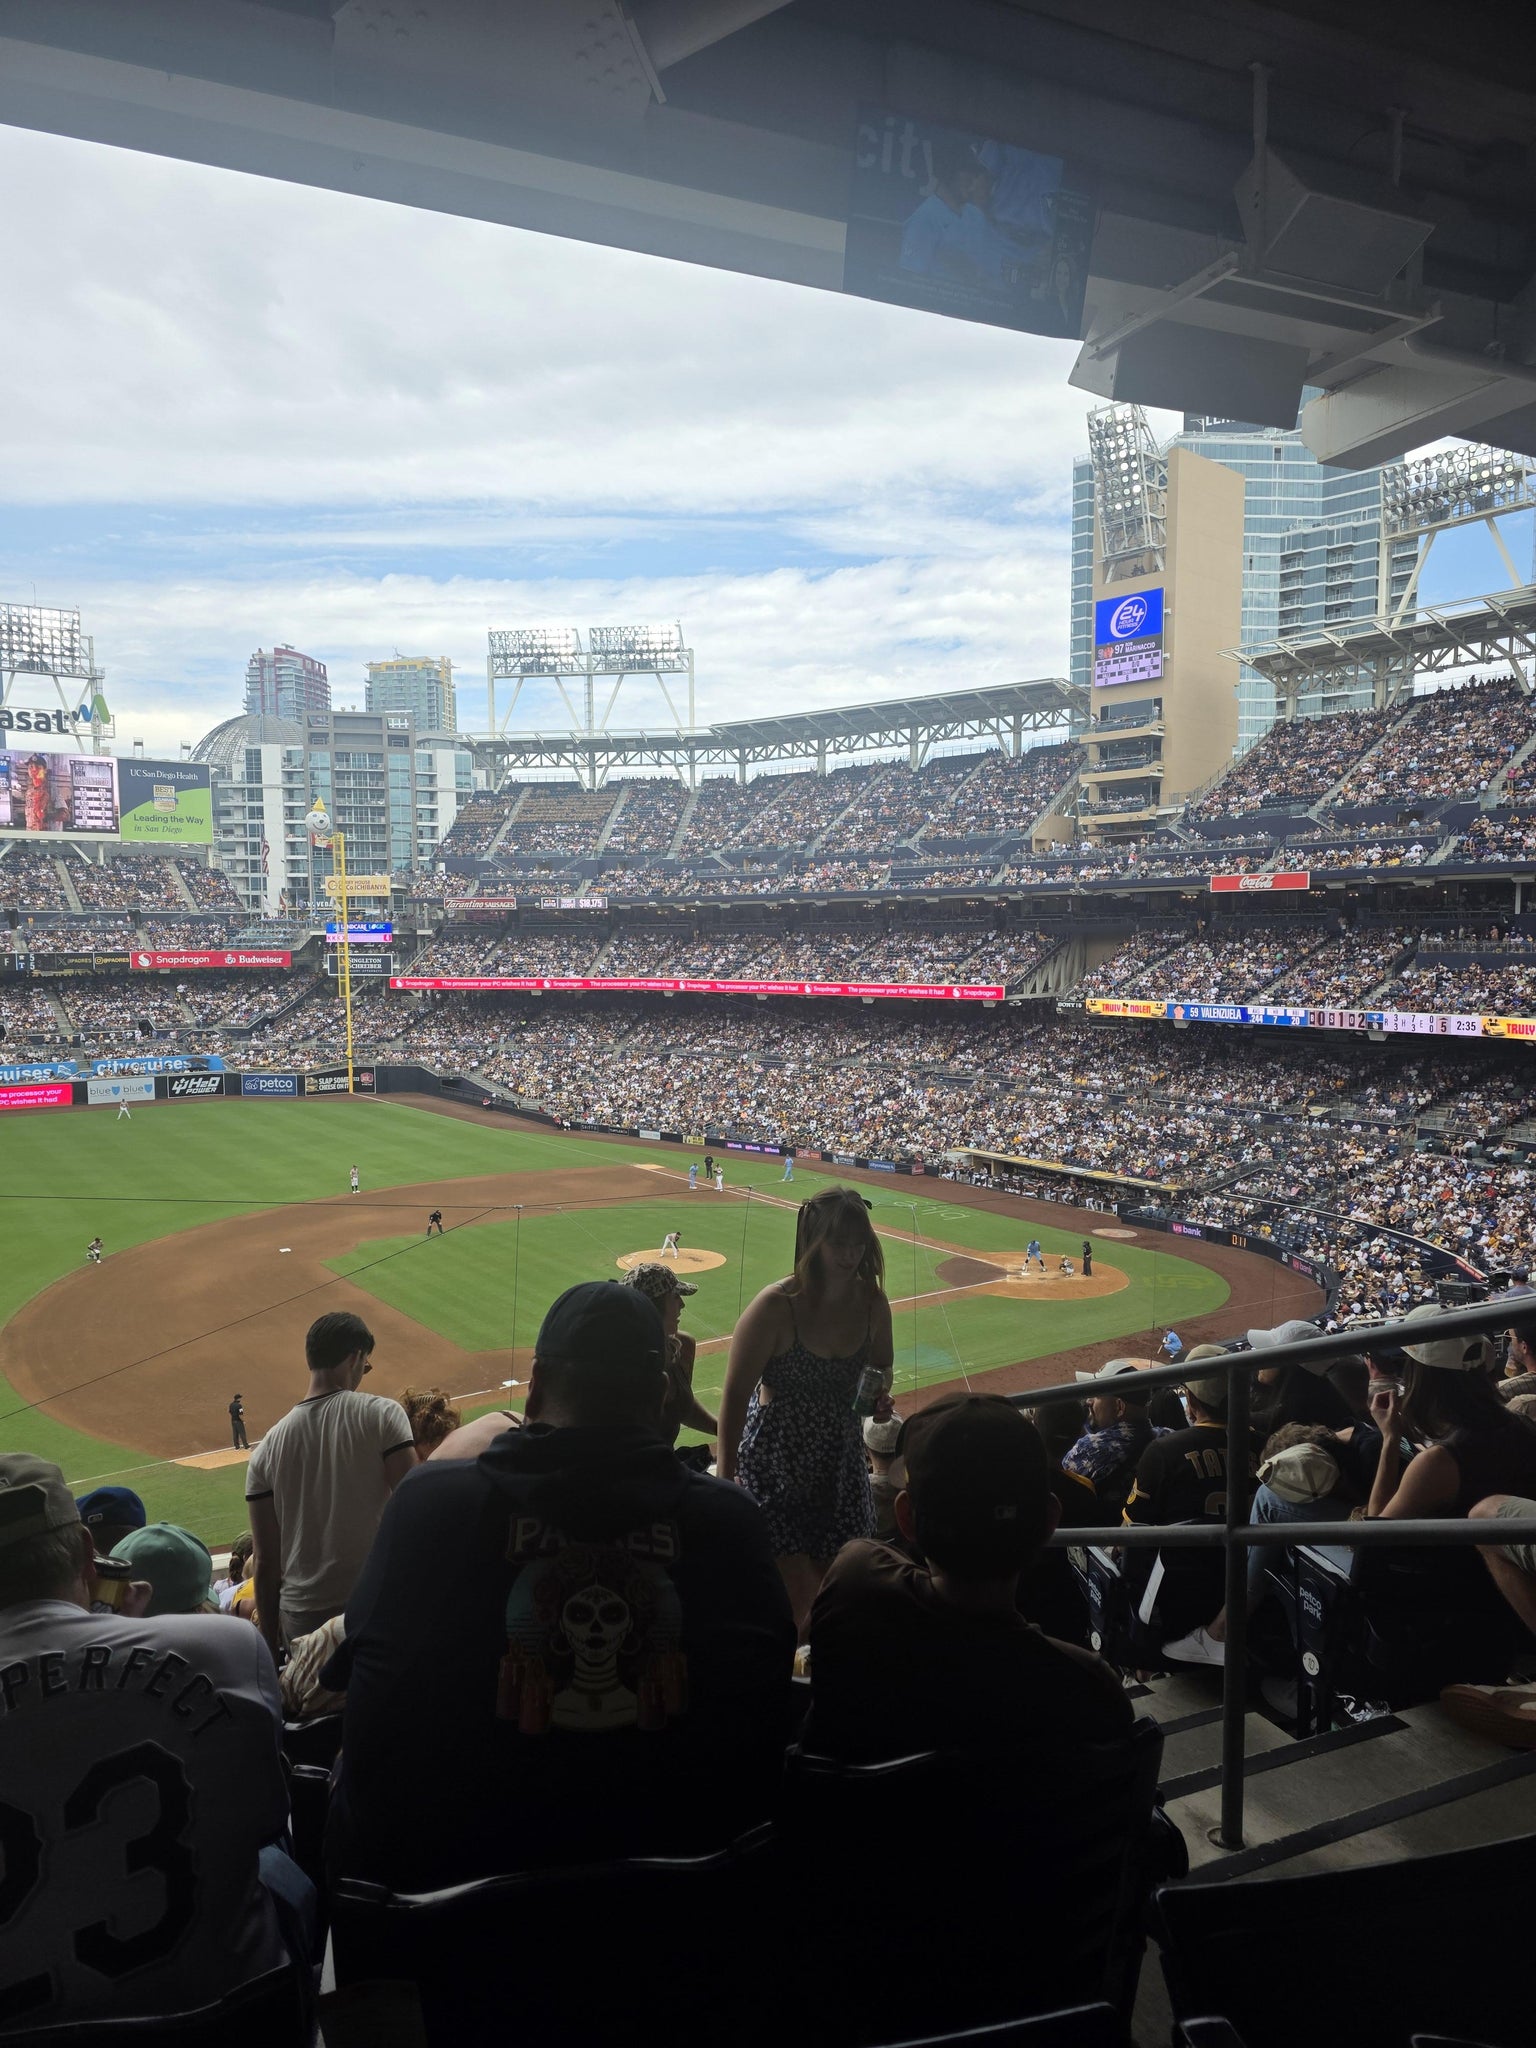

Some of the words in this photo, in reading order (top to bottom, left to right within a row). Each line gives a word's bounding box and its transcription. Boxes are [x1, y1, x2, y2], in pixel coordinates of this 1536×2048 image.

[1120, 604, 1144, 622] 24
[1114, 644, 1124, 654] 97
[0, 709, 69, 734] asat
[156, 771, 175, 780] Diego
[176, 772, 198, 780] Health
[134, 814, 168, 823] Leading
[186, 816, 204, 825] Way
[446, 900, 483, 908] Tarantino
[156, 955, 210, 965] Snapdragon
[239, 955, 283, 964] Budweiser
[1102, 1004, 1120, 1012] TRULY
[1130, 1004, 1151, 1014] NOLEN
[1190, 1008, 1198, 1017] 59
[1201, 1007, 1241, 1020] VALENZUELA
[1273, 1016, 1278, 1024] 7
[1292, 1016, 1300, 1025] 20
[1318, 1011, 1325, 1026] 0
[1339, 1012, 1343, 1027] 1
[1358, 1013, 1365, 1028] 2
[1441, 1022, 1446, 1032] 5
[1457, 1021, 1476, 1031] 2:35
[1506, 1023, 1535, 1035] TRULY
[188, 1076, 220, 1088] H2O
[260, 1078, 292, 1090] petco
[9, 1090, 44, 1098] processor
[1172, 1223, 1182, 1233] us
[1183, 1225, 1201, 1237] bank
[1300, 1586, 1322, 1610] petco
[1303, 1600, 1322, 1622] park
[1307, 1659, 1315, 1669] 10
[0, 1645, 233, 1737] PERFECT
